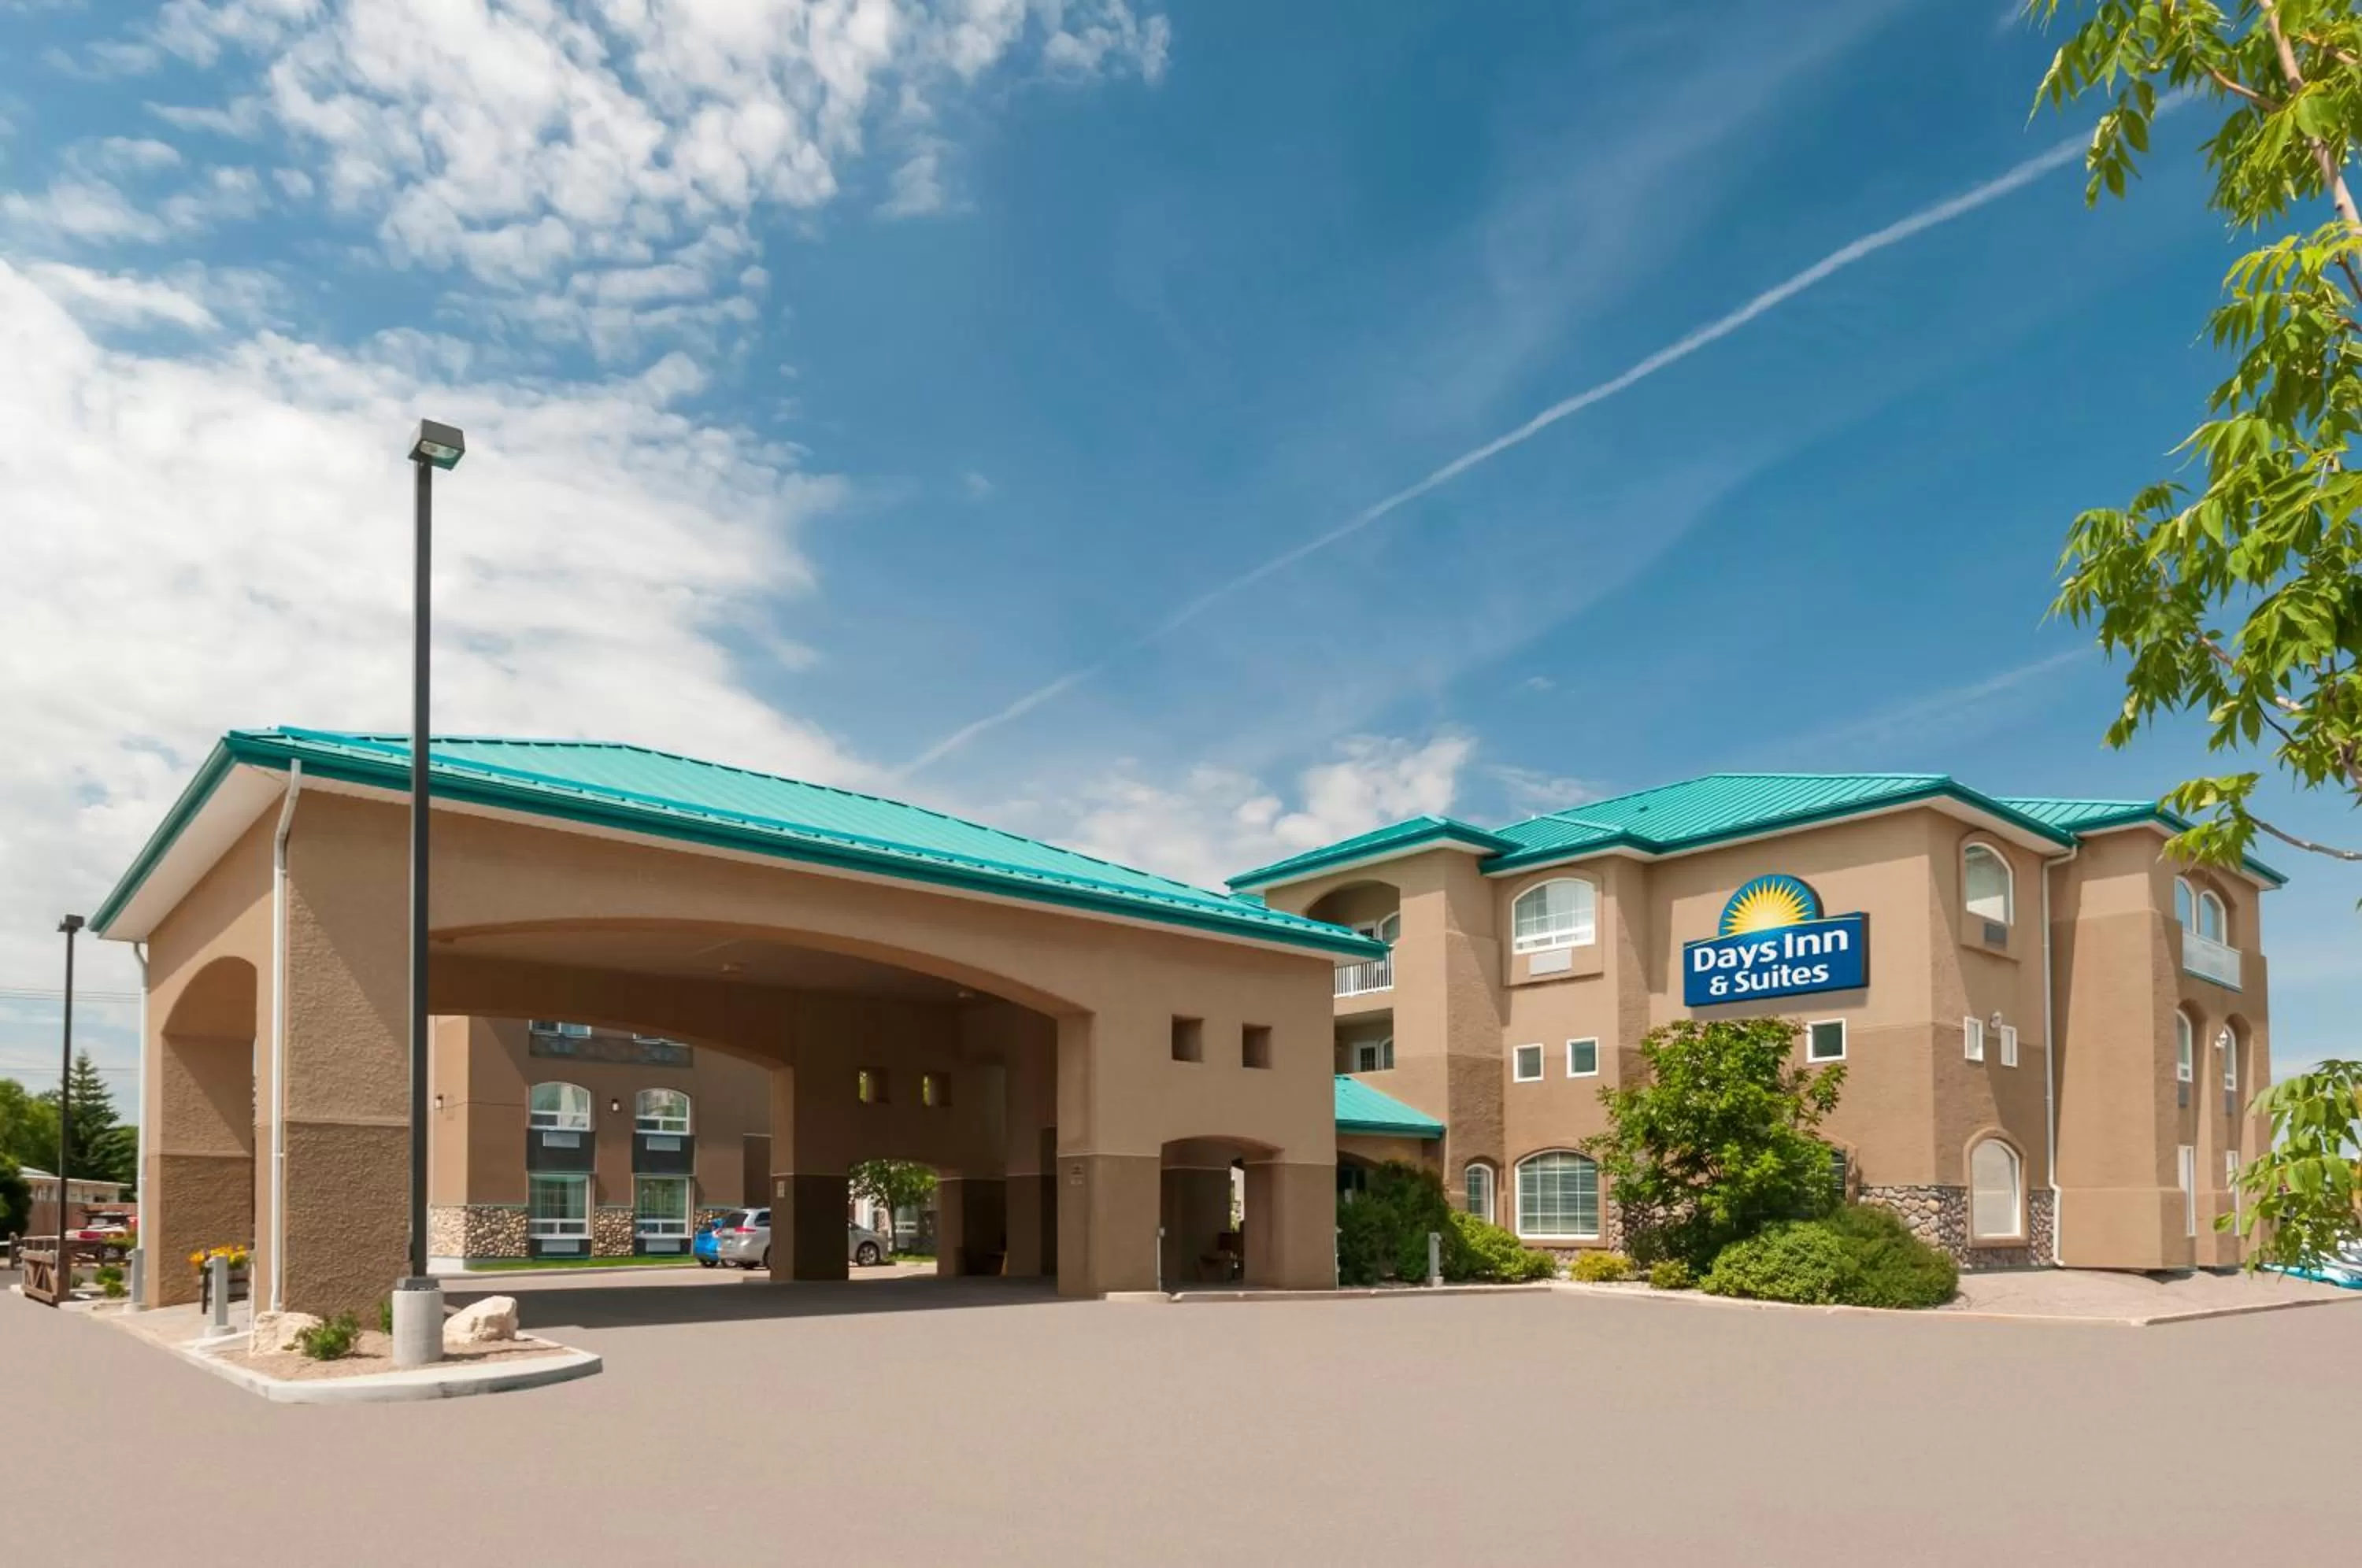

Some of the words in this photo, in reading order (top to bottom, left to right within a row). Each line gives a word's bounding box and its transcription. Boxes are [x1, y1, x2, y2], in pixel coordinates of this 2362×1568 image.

[1694, 941, 1778, 972] Days
[1784, 929, 1849, 960] Inn
[1709, 975, 1729, 996] &
[1734, 963, 1829, 993] Suites
